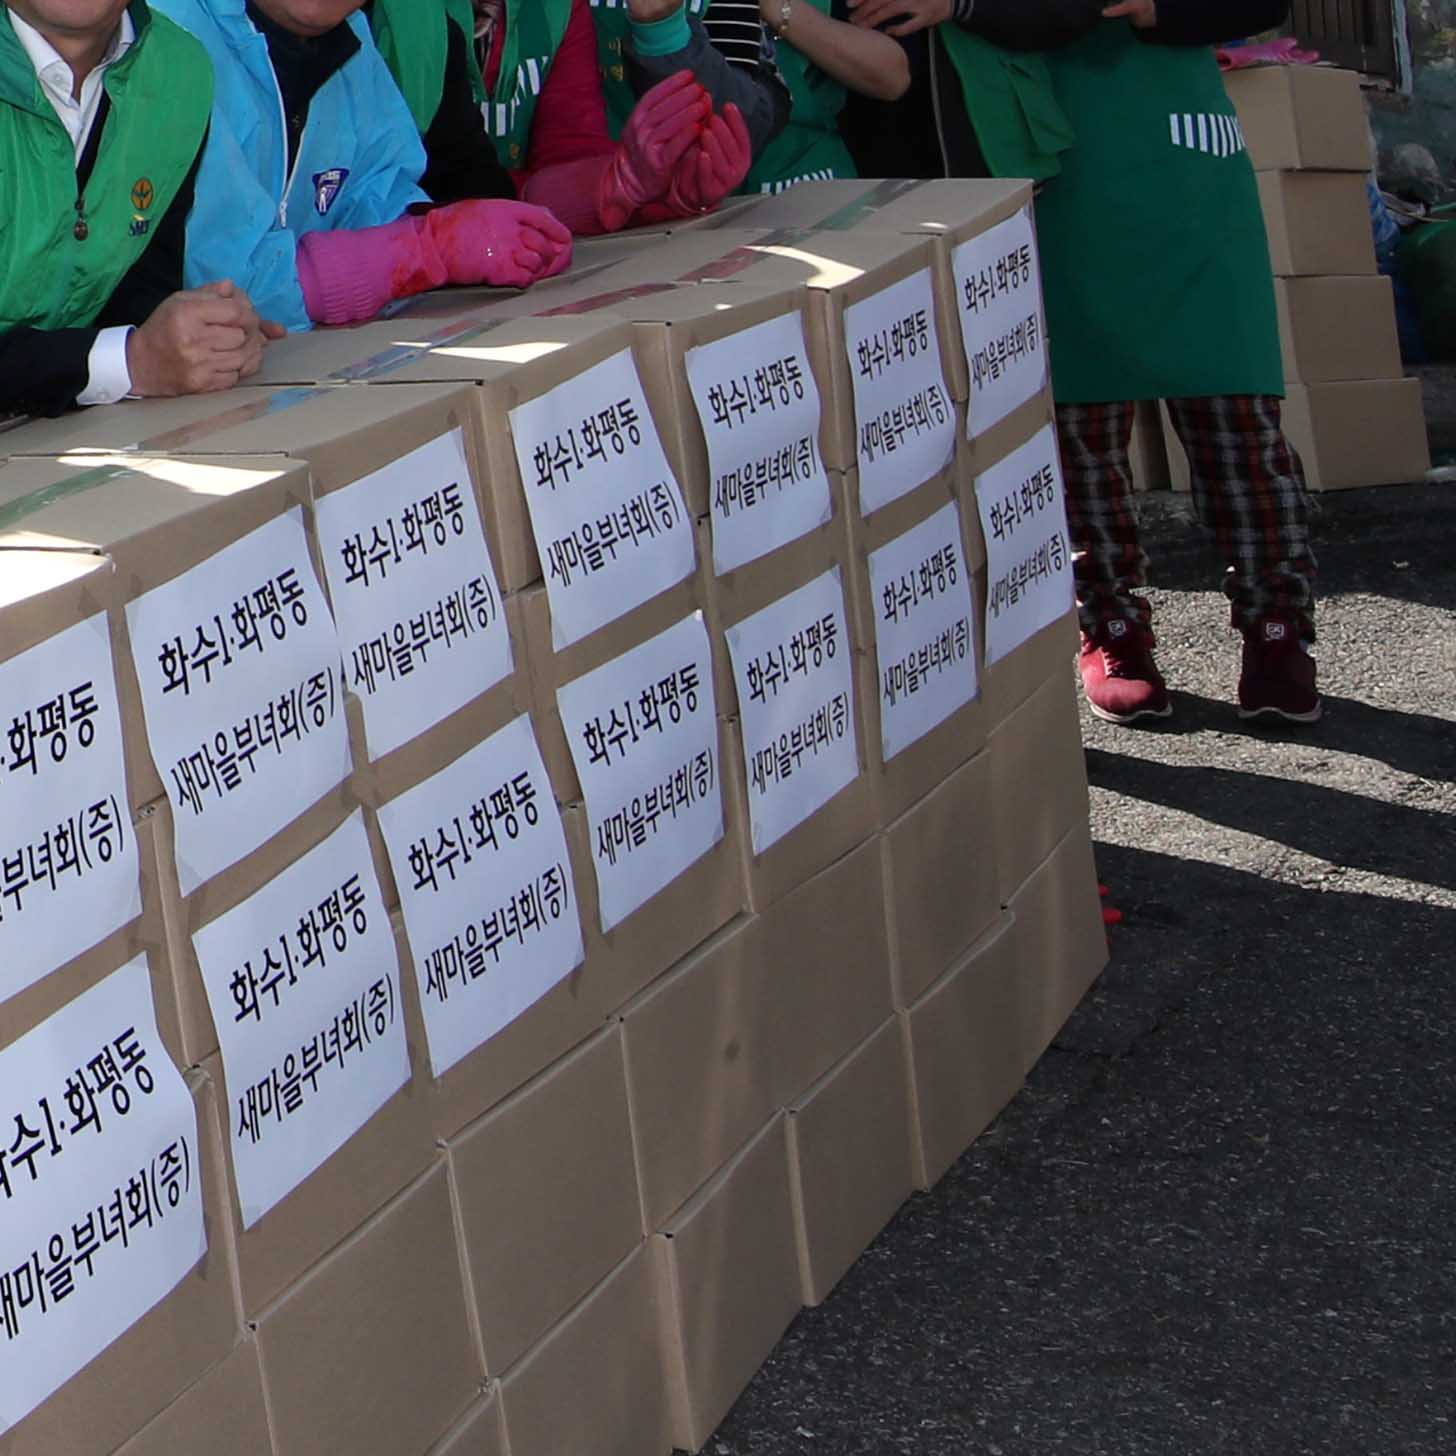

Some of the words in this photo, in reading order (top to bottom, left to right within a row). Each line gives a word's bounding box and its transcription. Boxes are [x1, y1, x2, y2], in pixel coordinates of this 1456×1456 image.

[548, 482, 680, 588] 새마을부녀회(증)
[352, 575, 495, 696] 새마을부녀회(증)
[171, 667, 334, 815] 새마을부녀회(증)
[751, 691, 849, 794] 새마을부녀회(증)
[596, 748, 714, 867] 새마을부녀회(증)
[425, 864, 567, 1001] 새마을부녀회(증)
[237, 974, 393, 1144] 새마을부녀회(증)
